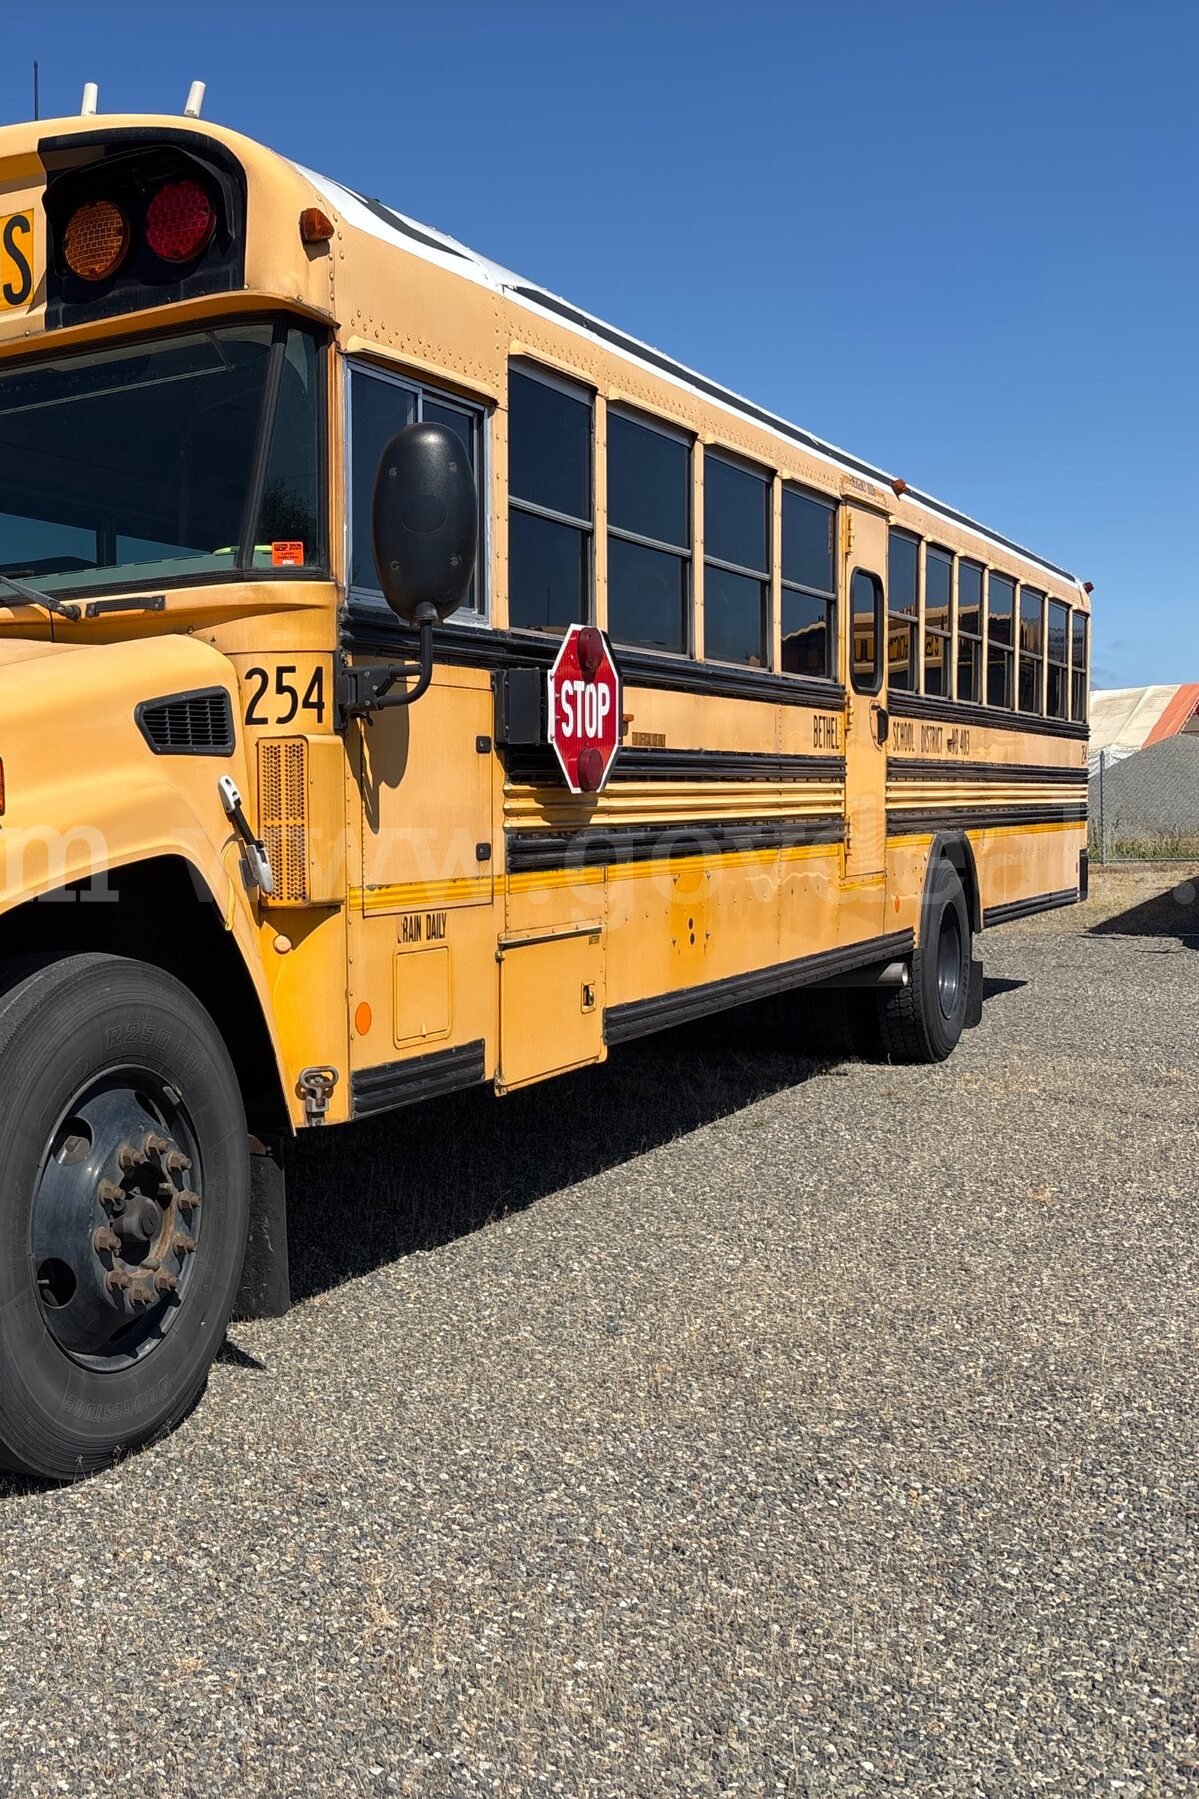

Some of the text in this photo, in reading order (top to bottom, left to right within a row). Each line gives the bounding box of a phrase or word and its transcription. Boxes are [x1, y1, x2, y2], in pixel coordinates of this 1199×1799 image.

[244, 665, 325, 726] 254
[561, 680, 611, 739] STOP
[813, 714, 839, 749] BETHEL
[893, 721, 914, 752] SCHOOL
[921, 724, 943, 754] DISTRICT
[397, 911, 447, 944] RAIN DAILY
